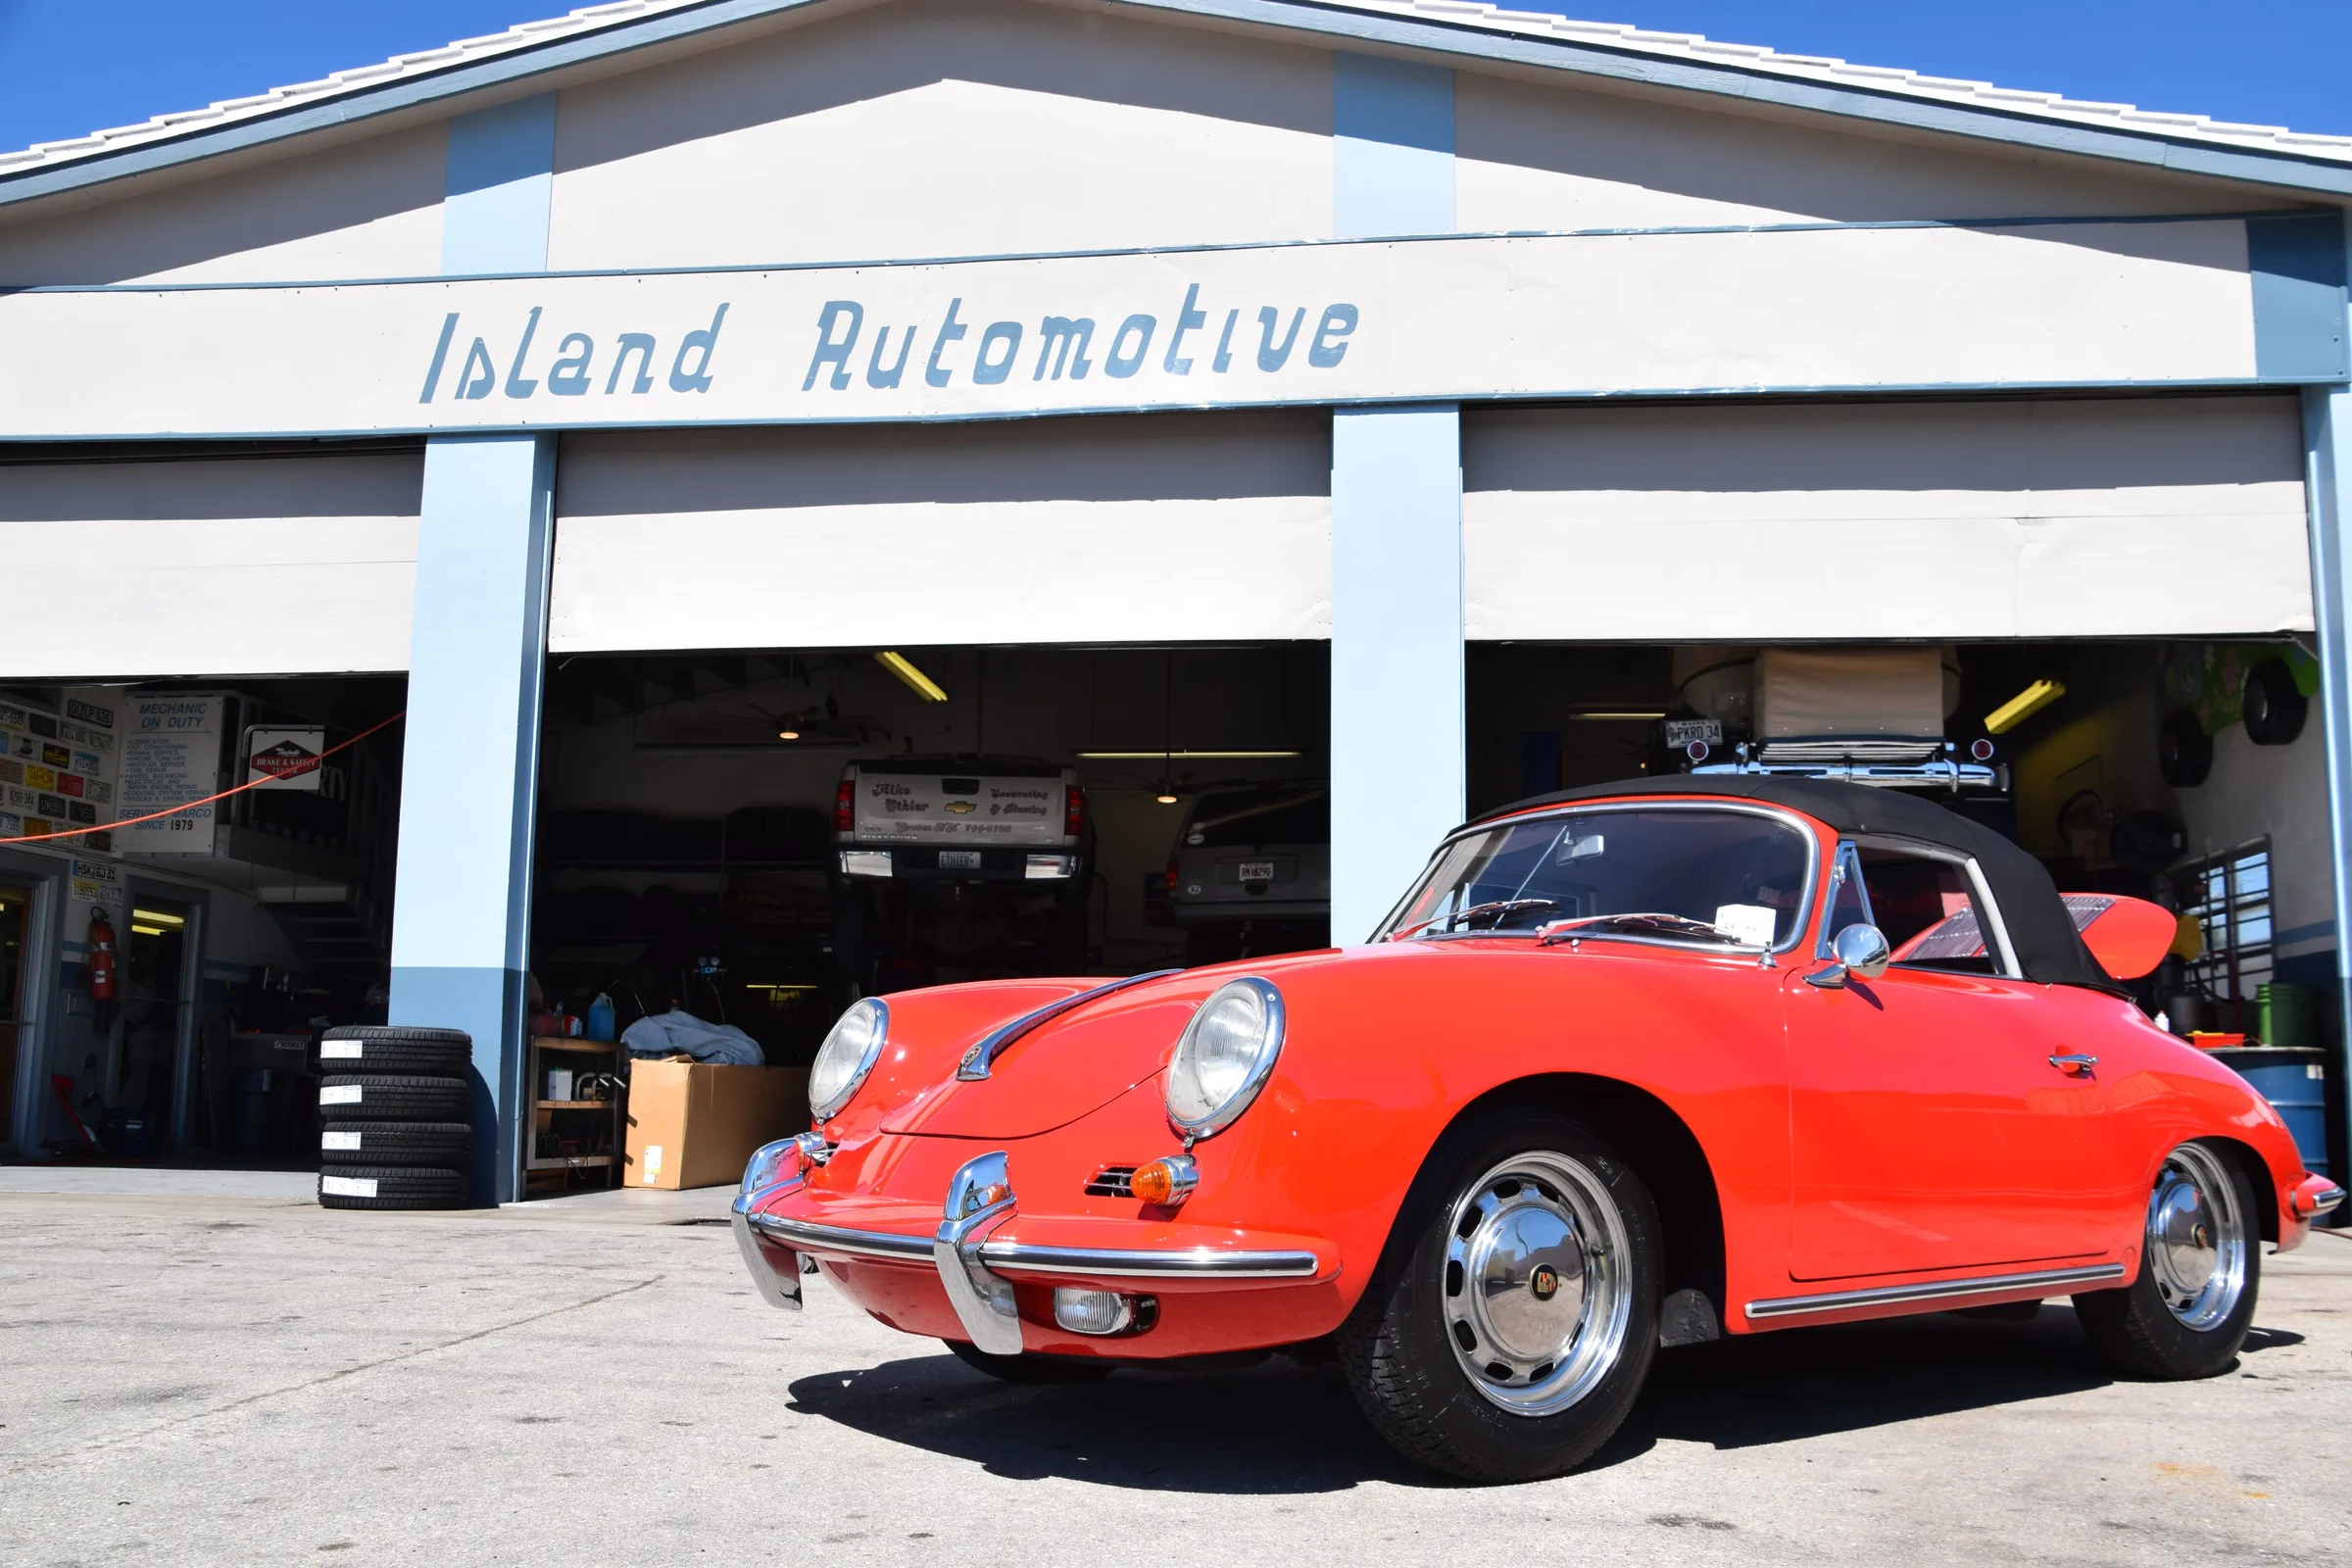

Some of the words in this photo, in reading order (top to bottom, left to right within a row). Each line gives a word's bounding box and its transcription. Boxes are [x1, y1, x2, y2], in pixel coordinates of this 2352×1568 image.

[418, 302, 731, 404] Island
[802, 283, 1360, 393] Automotive
[139, 703, 208, 714] MECHANIC
[141, 716, 162, 728] ON
[168, 716, 205, 728] DUTY
[1677, 725, 1703, 741] PKRD
[1706, 724, 1720, 739] 34
[119, 809, 166, 820] SERVING
[172, 808, 212, 818] MARCO
[135, 820, 166, 830] SINCE
[171, 819, 194, 831] 1979
[77, 862, 91, 876] HSK
[96, 867, 106, 879] GJ
[107, 868, 116, 880] 31
